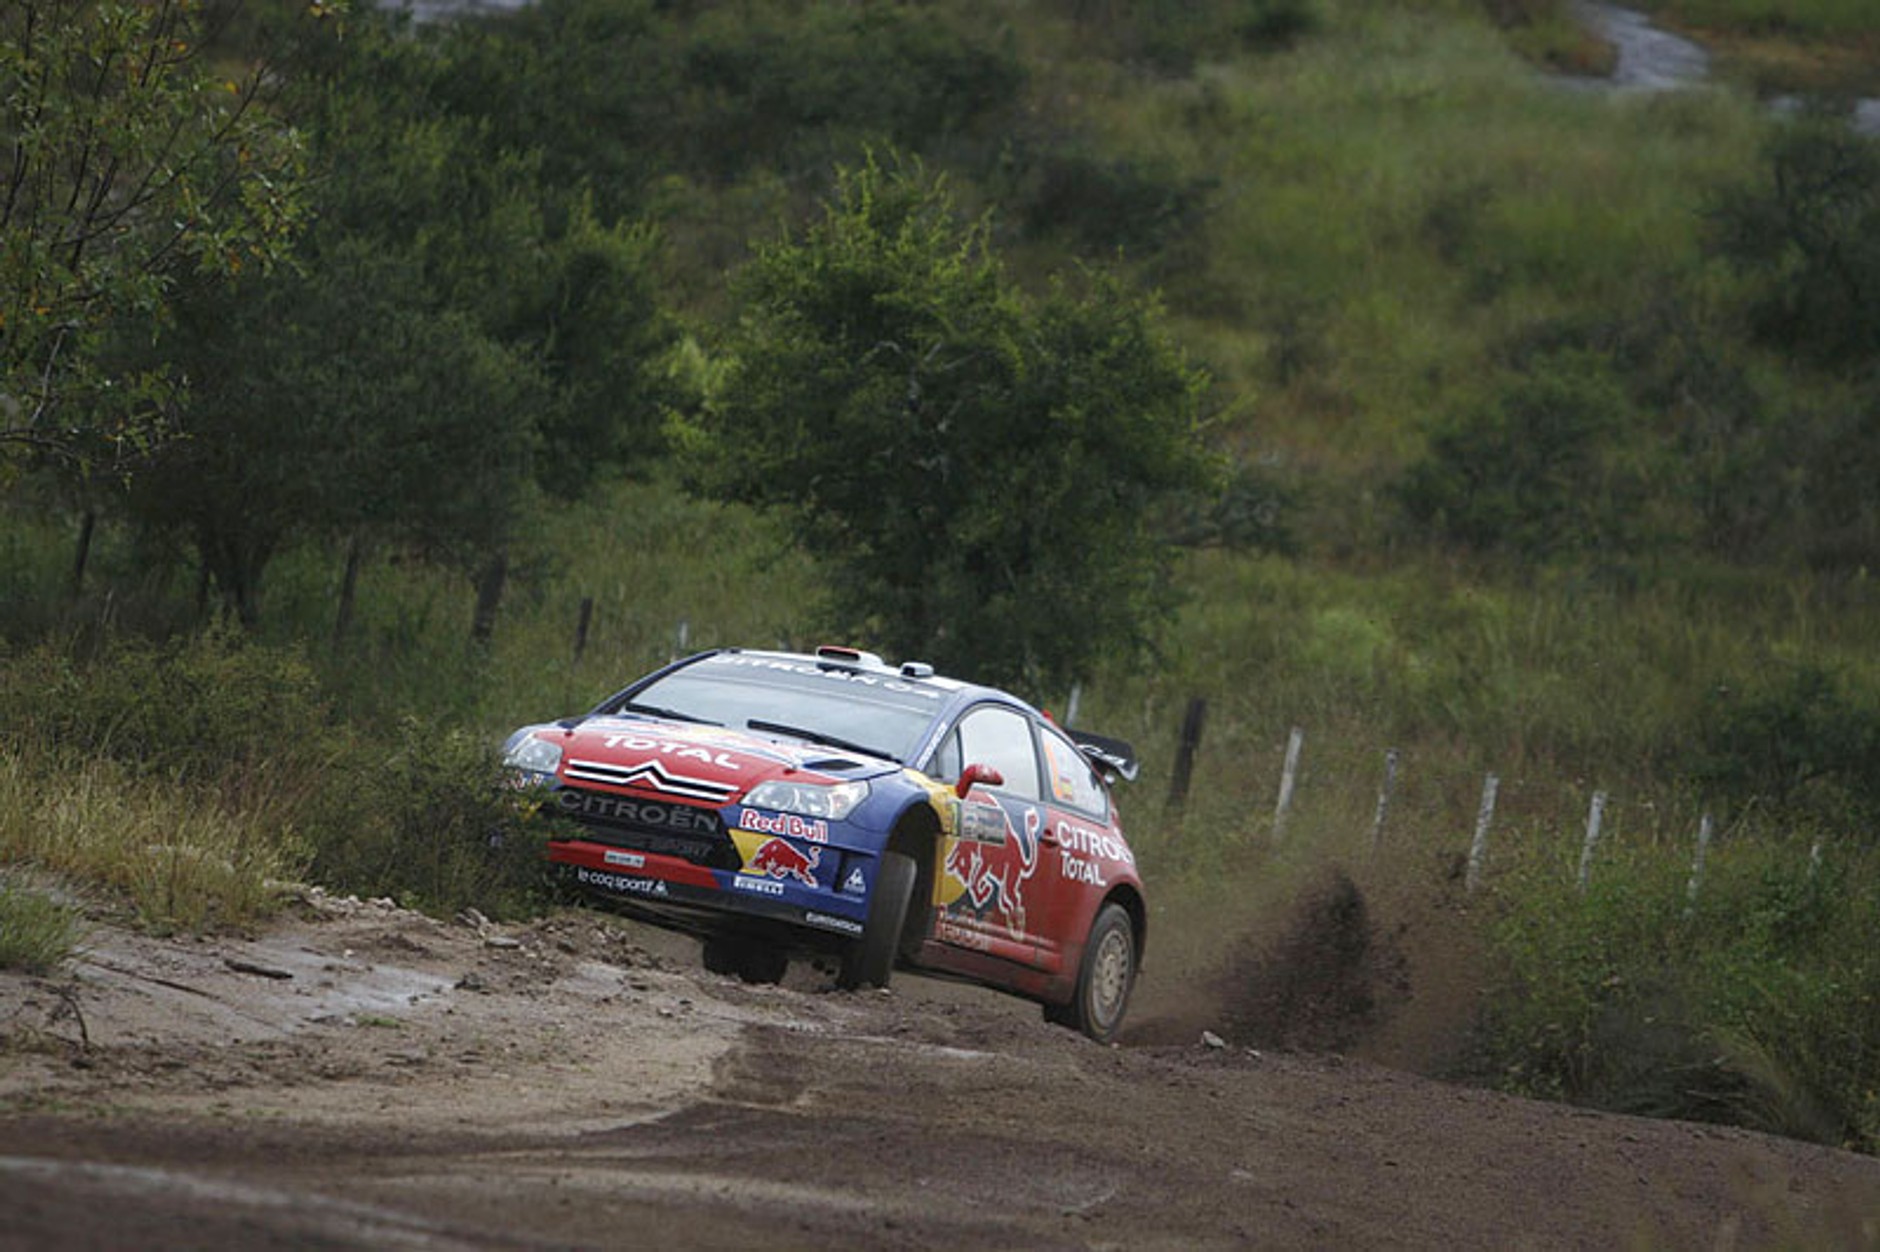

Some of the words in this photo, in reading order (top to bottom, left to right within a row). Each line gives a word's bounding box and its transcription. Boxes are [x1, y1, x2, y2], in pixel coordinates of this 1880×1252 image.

[603, 734, 740, 769] TOTAL
[561, 790, 718, 832] CITROËN
[740, 808, 787, 835] Red
[787, 815, 829, 844] Bull
[1060, 849, 1107, 887] TOTAL
